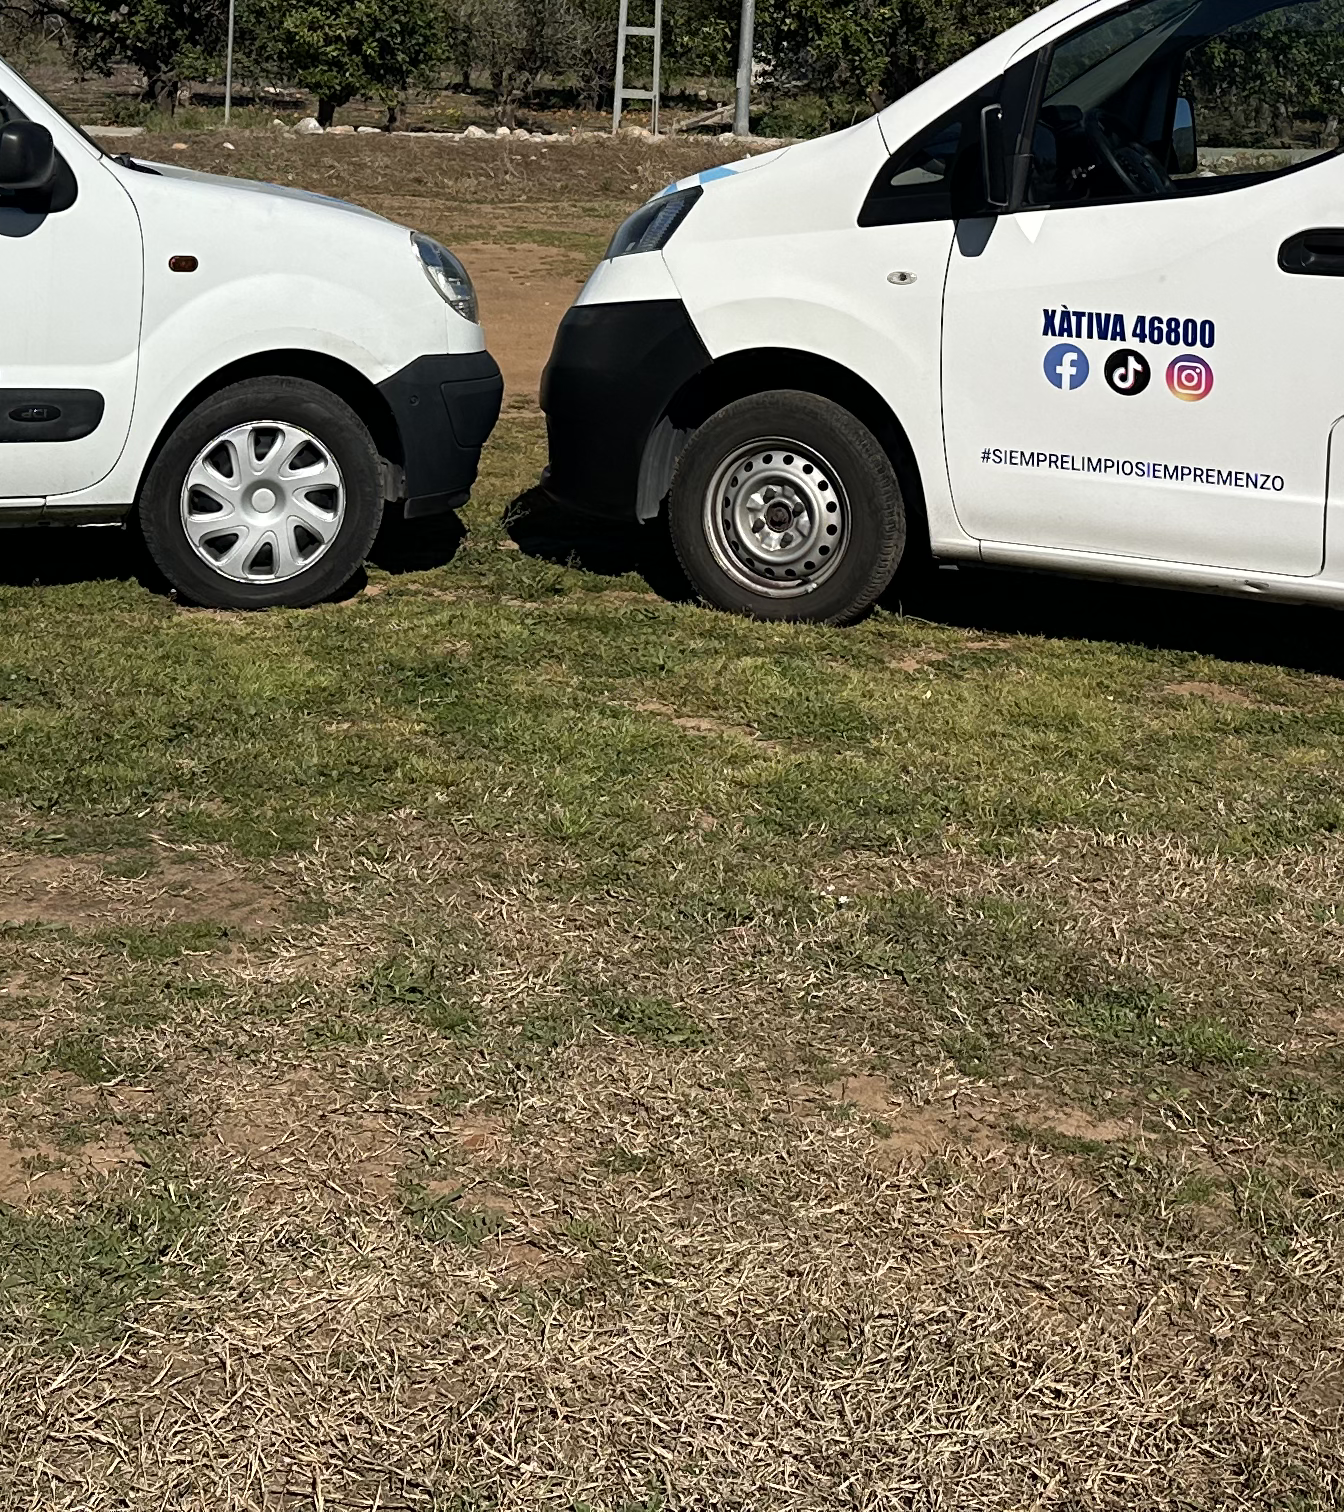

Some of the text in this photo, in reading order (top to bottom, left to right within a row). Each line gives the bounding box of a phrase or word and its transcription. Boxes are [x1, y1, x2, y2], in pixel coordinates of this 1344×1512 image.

[1042, 305, 1215, 348] XÀTIVA 46800
[981, 448, 1285, 492] #SIEMPRELIMPIOSIEMPREMENZO
